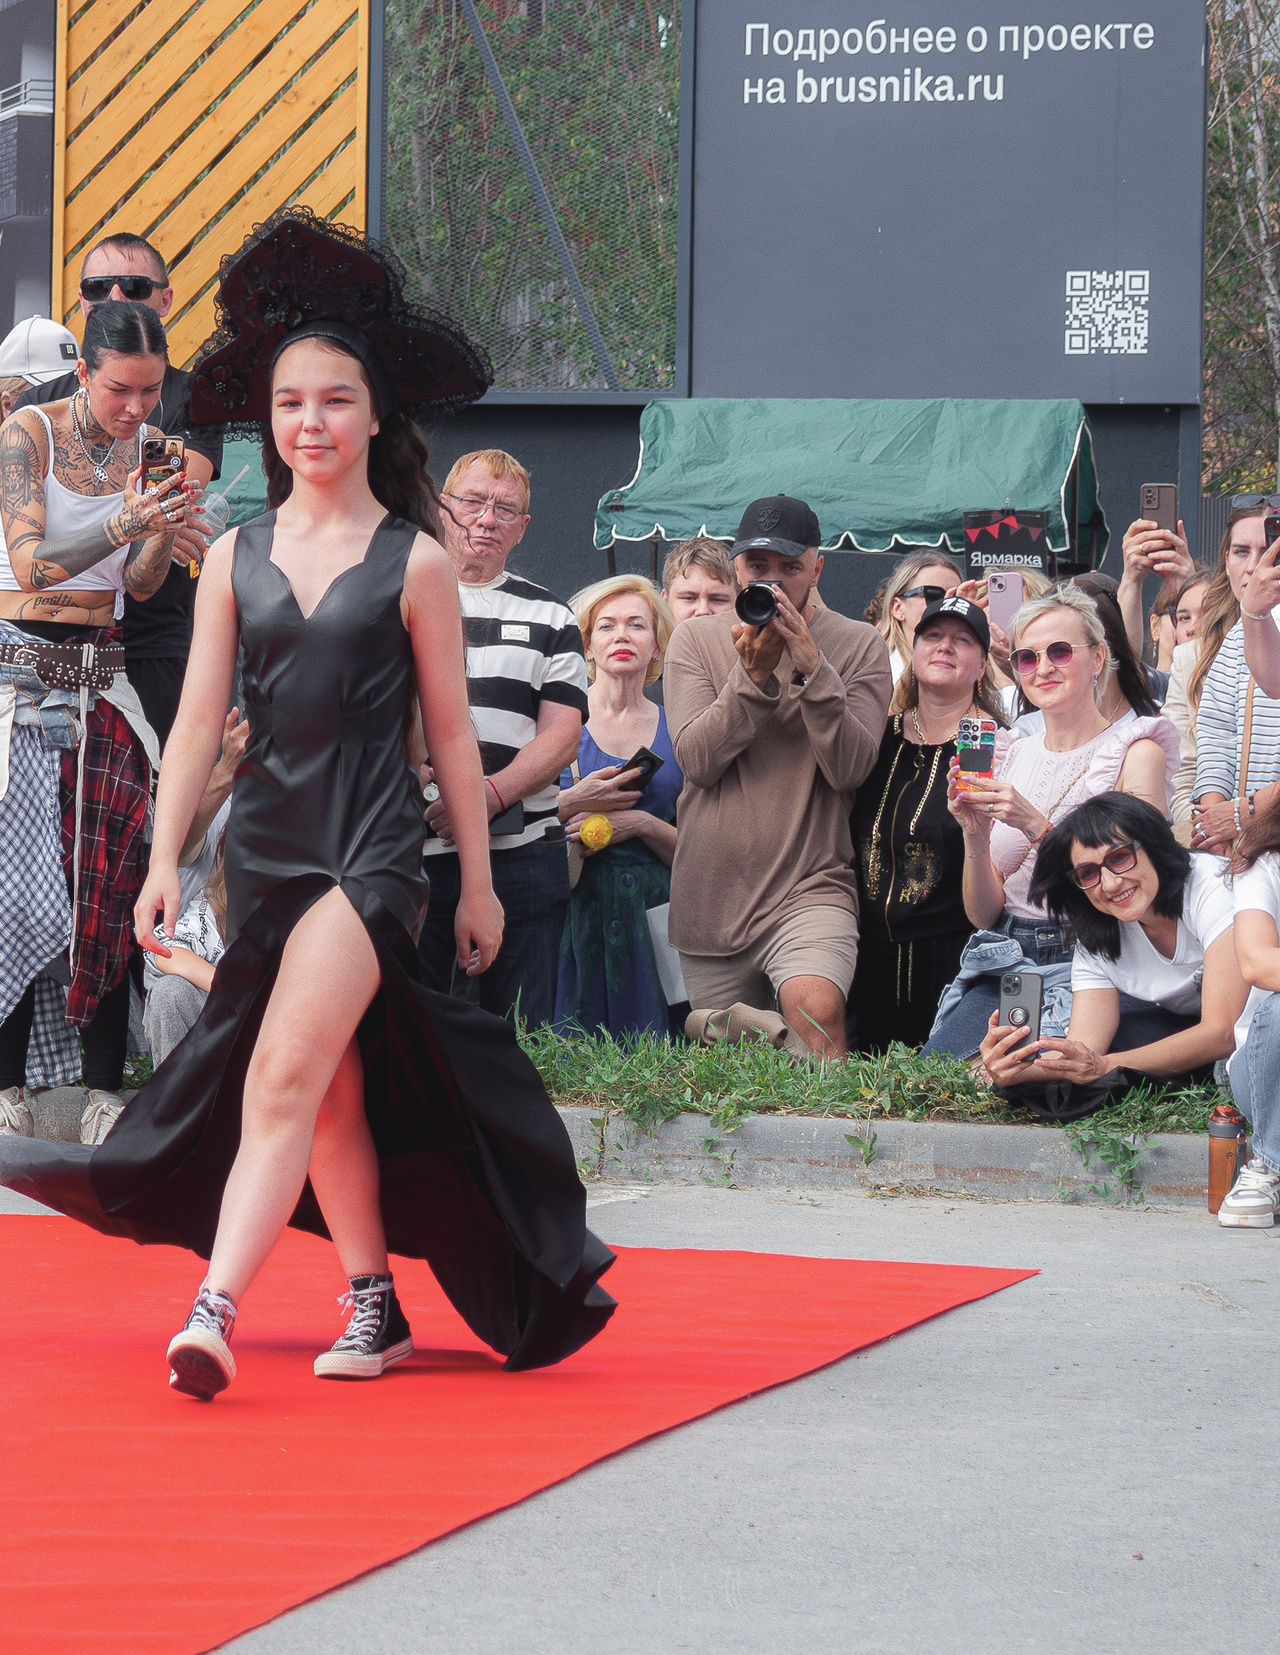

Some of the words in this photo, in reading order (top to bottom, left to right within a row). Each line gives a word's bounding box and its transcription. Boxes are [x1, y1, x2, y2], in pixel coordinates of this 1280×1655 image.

[745, 18, 957, 63] Подробнее
[966, 25, 988, 53] о
[999, 22, 1155, 60] проекте
[743, 77, 787, 104] на
[796, 66, 1004, 104] brusnika.ru
[970, 551, 1043, 567] Ярмарка
